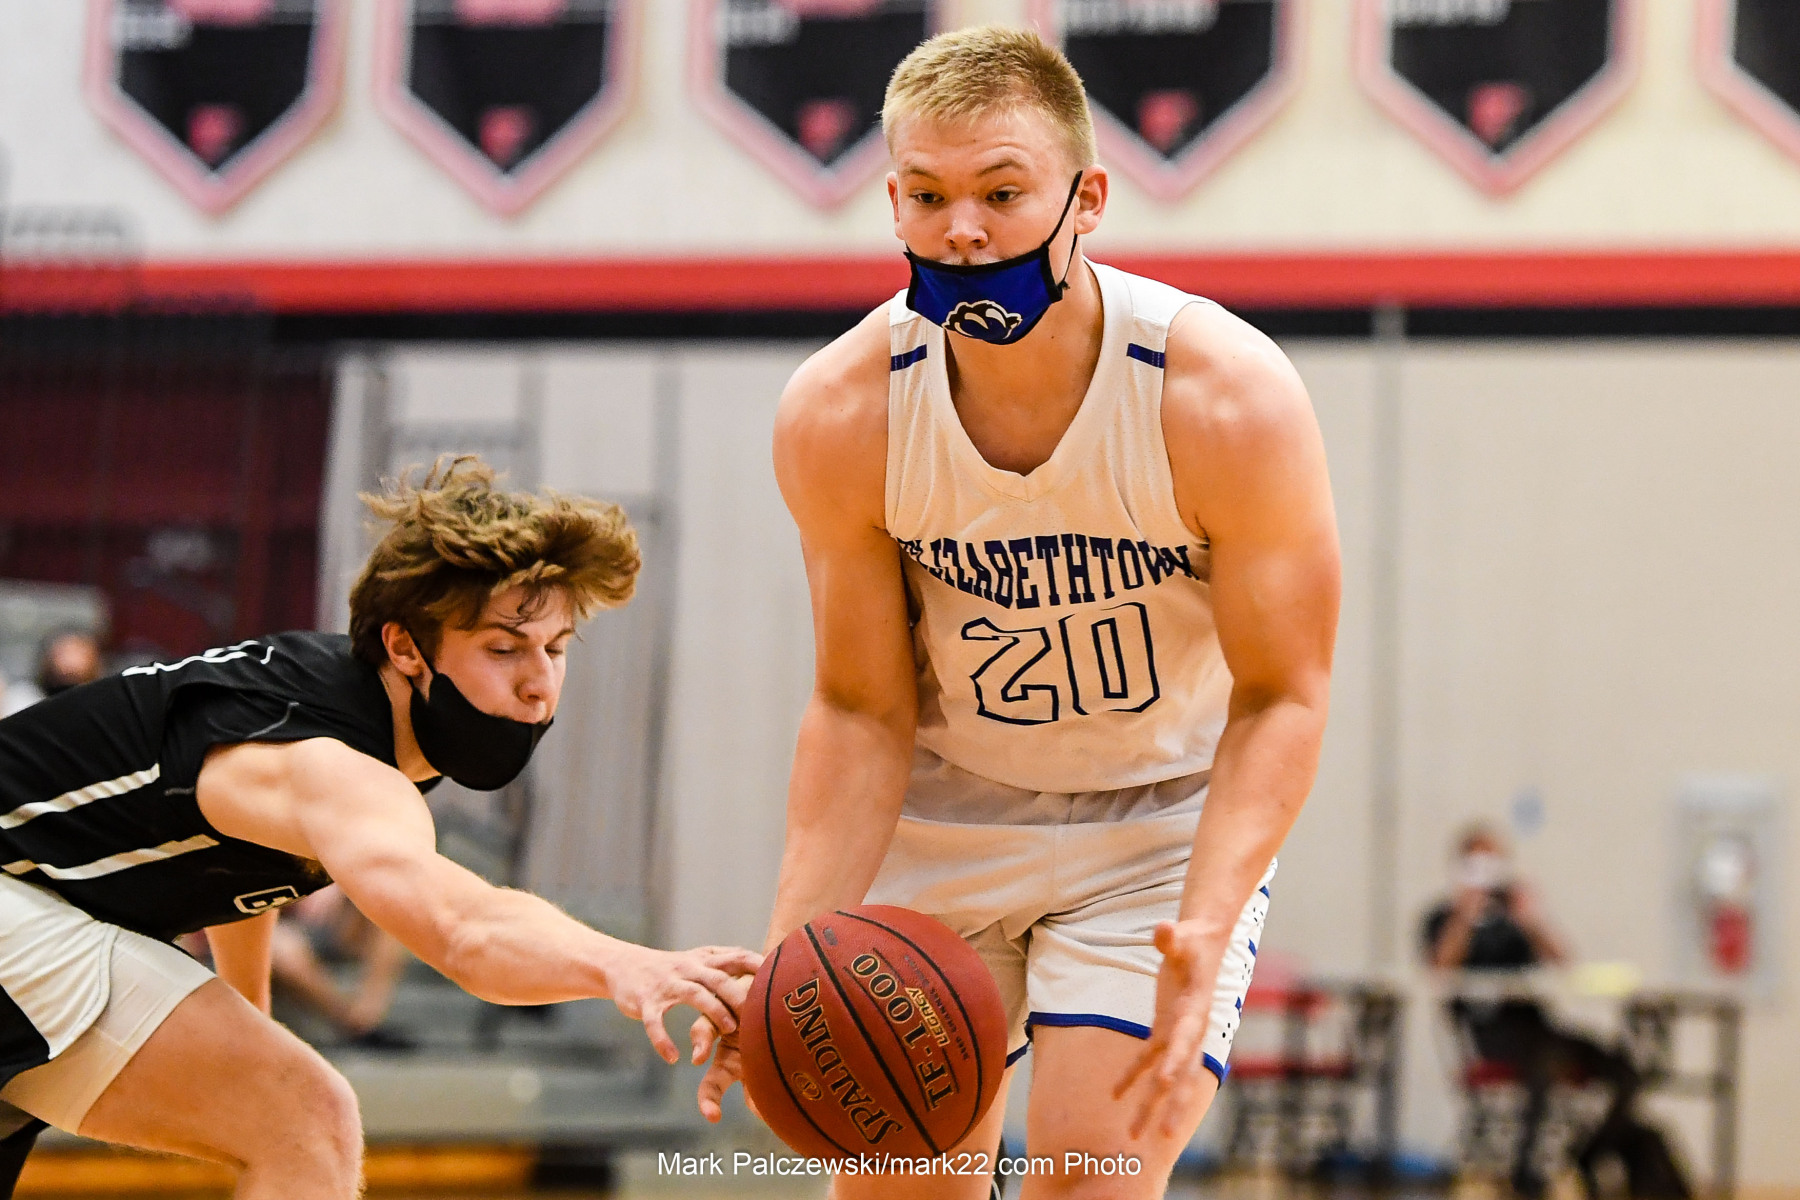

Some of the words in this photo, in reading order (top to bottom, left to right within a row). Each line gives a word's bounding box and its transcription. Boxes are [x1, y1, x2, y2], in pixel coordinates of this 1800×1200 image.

[961, 601, 1160, 726] 20
[782, 976, 905, 1145] SPALDING
[851, 953, 955, 1112] TF-1000
[904, 986, 950, 1048] LEGACY
